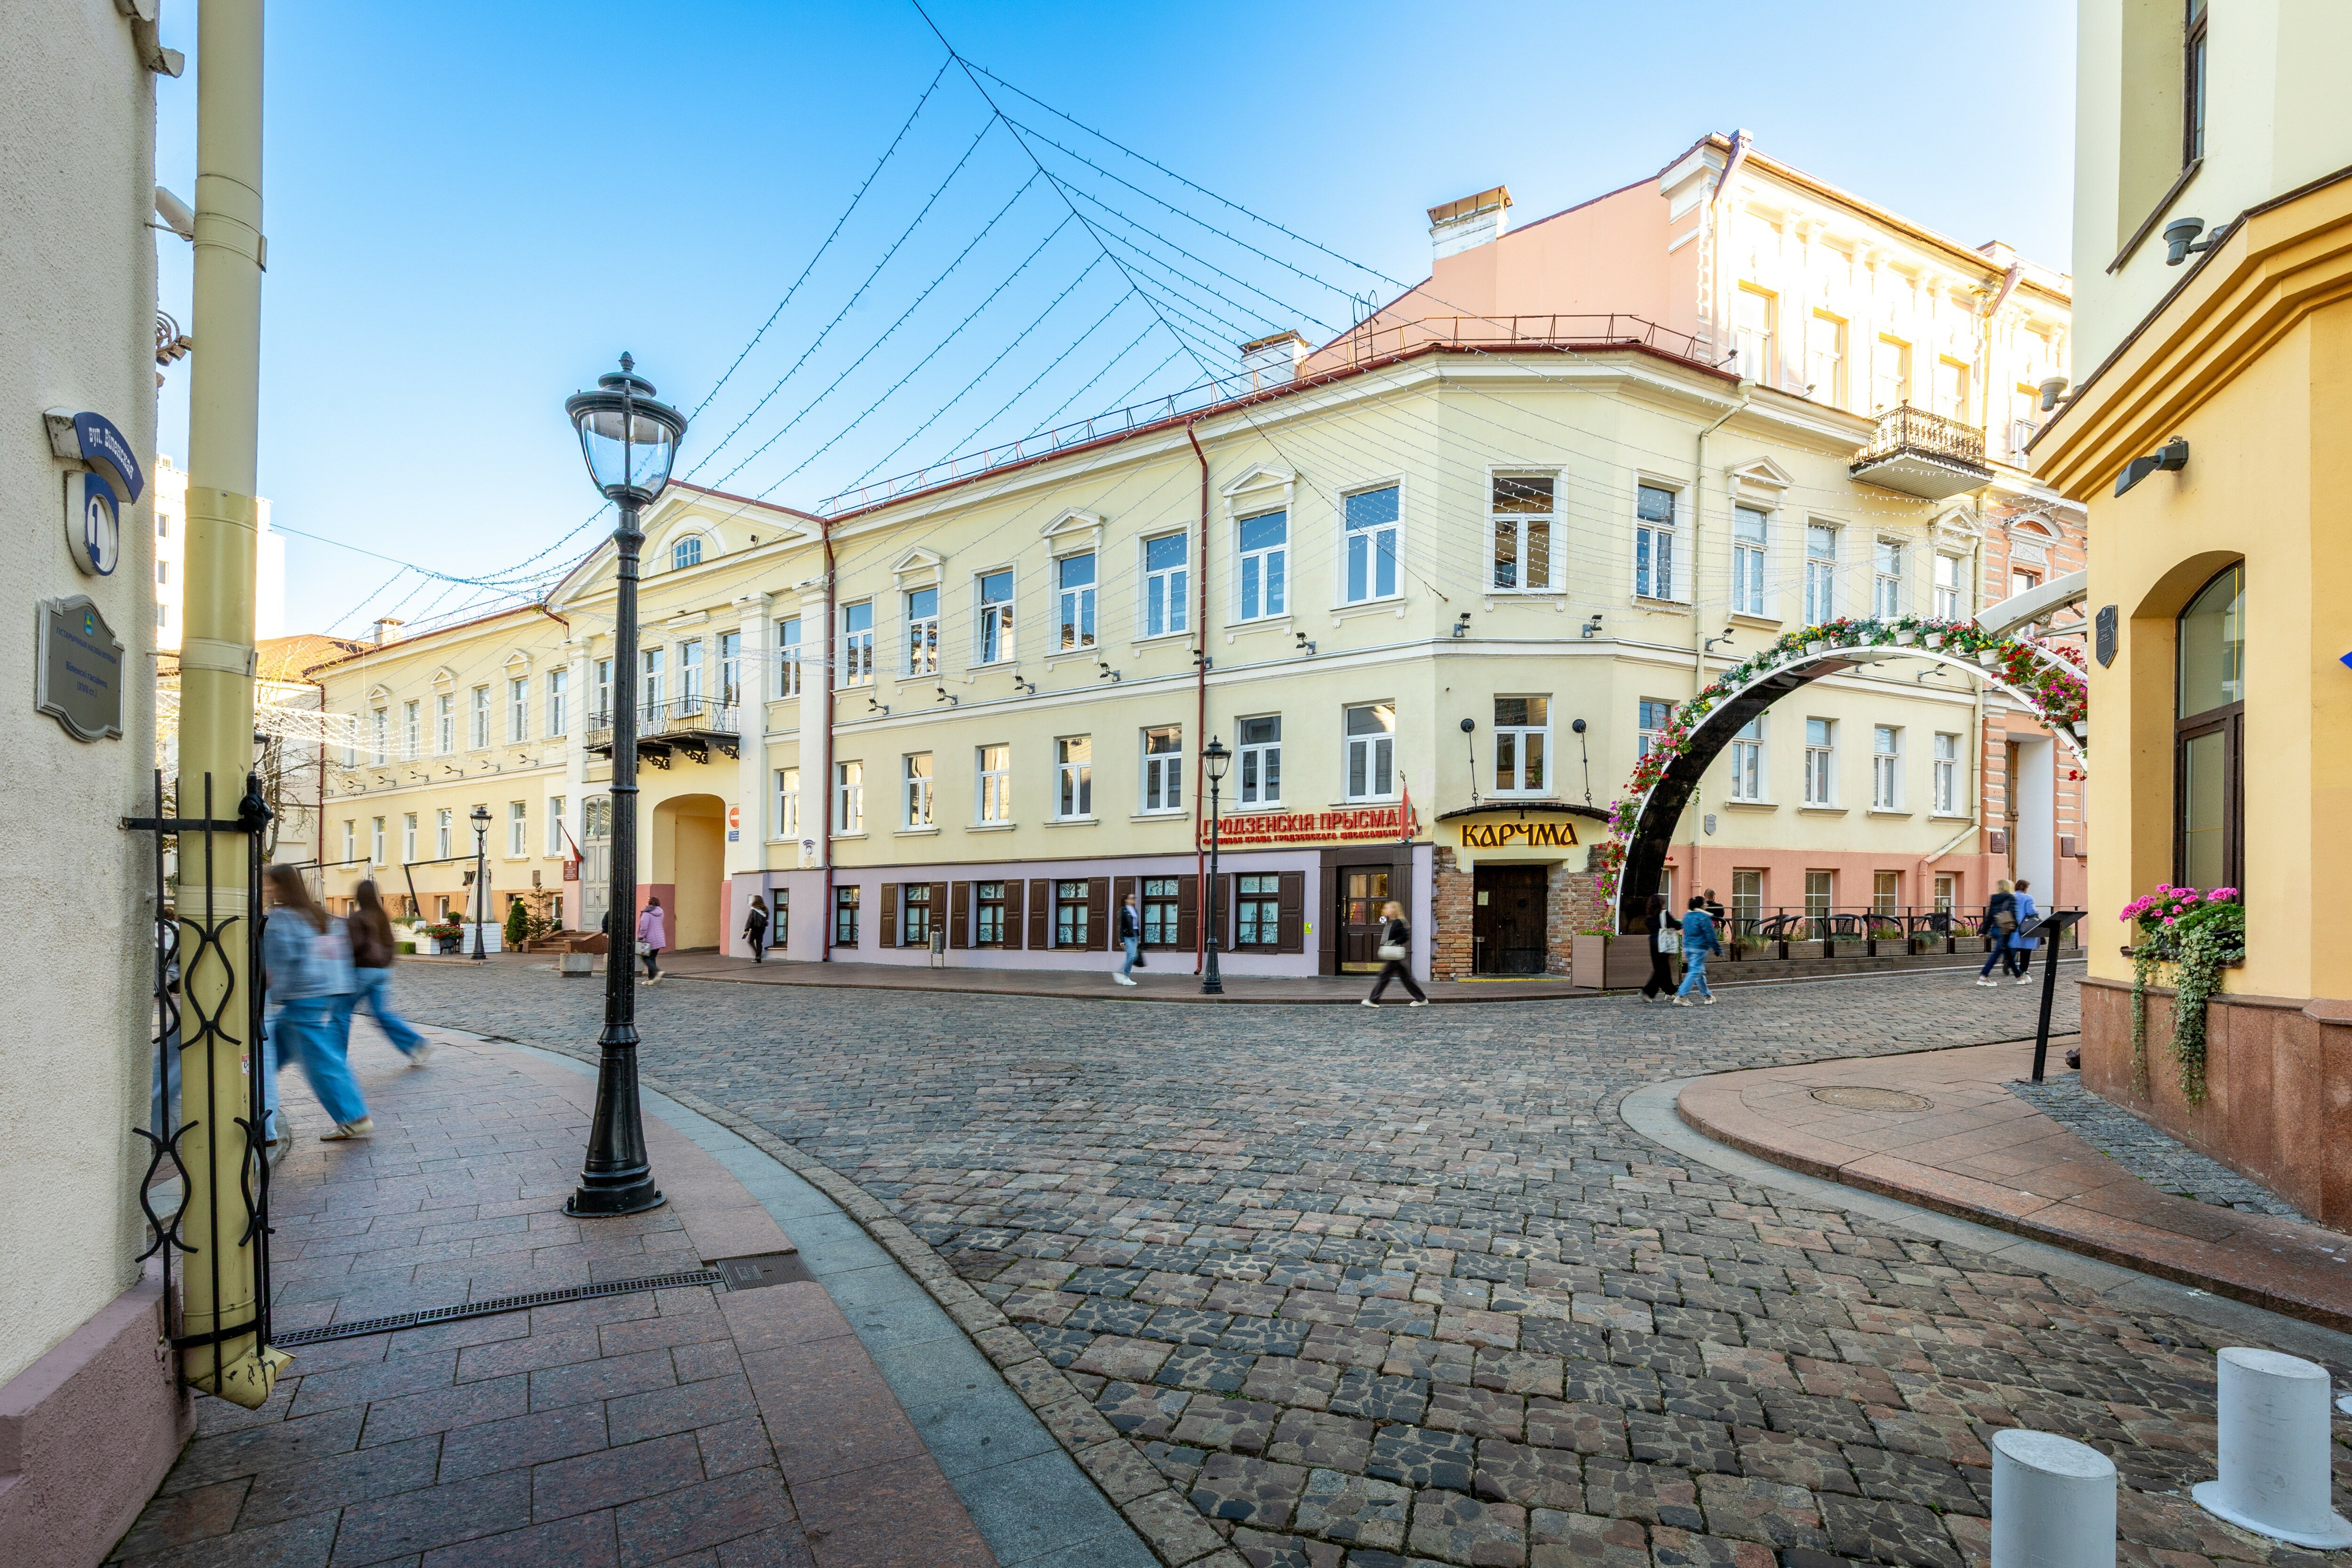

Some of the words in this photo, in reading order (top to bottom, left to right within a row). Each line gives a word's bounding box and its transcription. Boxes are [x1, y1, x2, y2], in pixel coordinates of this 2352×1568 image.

[89, 427, 103, 447] вул.
[105, 428, 134, 480] Віленская
[91, 503, 100, 564] 1
[66, 661, 87, 678] Віленскі
[1274, 833, 1337, 842] ГРОДЗЕНСКАГА
[1341, 828, 1415, 839] МЯСАКАМБІНА
[1462, 823, 1579, 847] КАРЧМА
